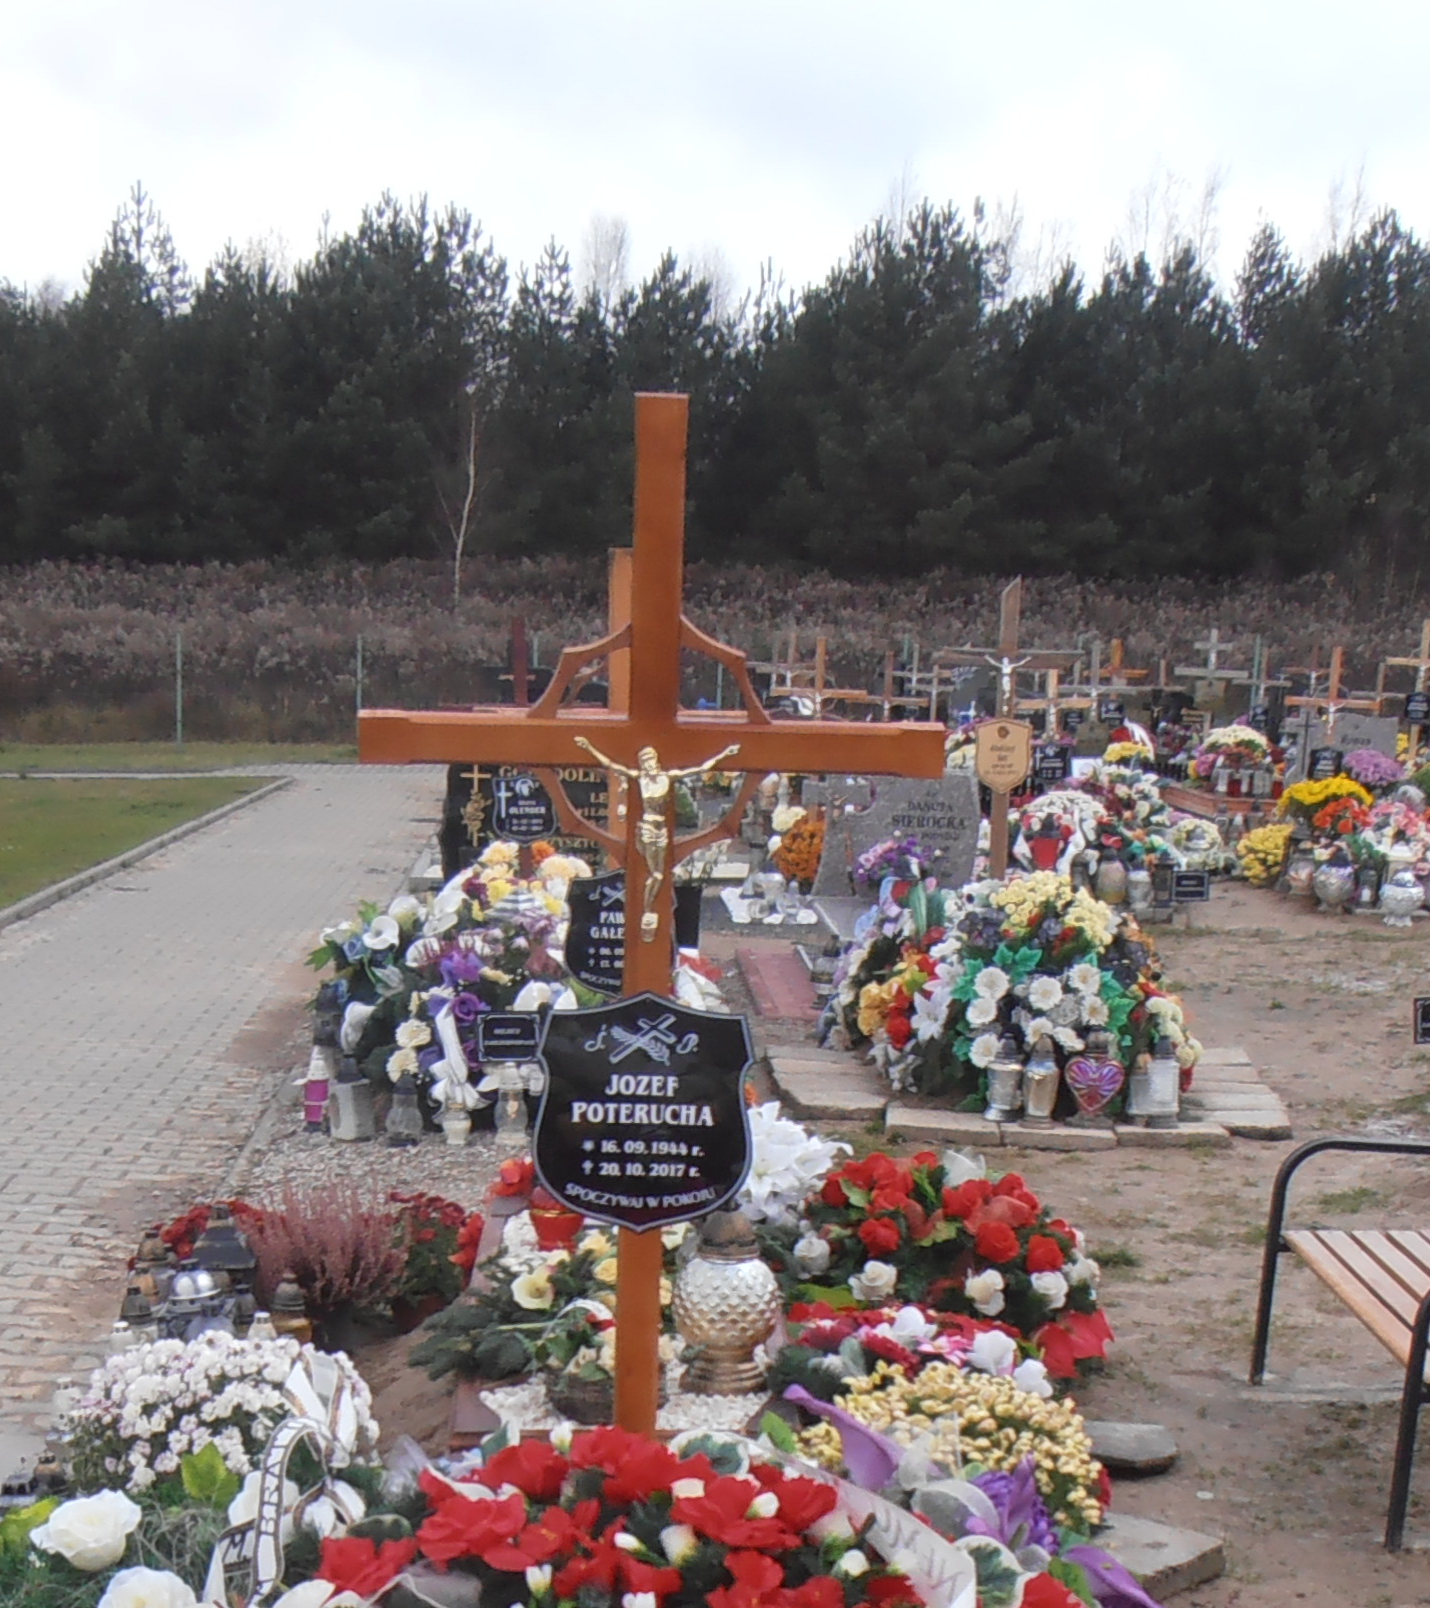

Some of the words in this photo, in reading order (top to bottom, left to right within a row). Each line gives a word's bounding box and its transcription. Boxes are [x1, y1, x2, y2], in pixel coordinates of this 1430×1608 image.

[571, 1102, 715, 1126] POTERUCHA
[600, 1140, 621, 1153] 16.
[626, 1163, 646, 1176] 10.
[649, 1163, 686, 1177] 2017
[564, 1183, 643, 1209] SPOCZYWAJ
[645, 1196, 661, 1208] W
[662, 1188, 715, 1207] POKOJU
